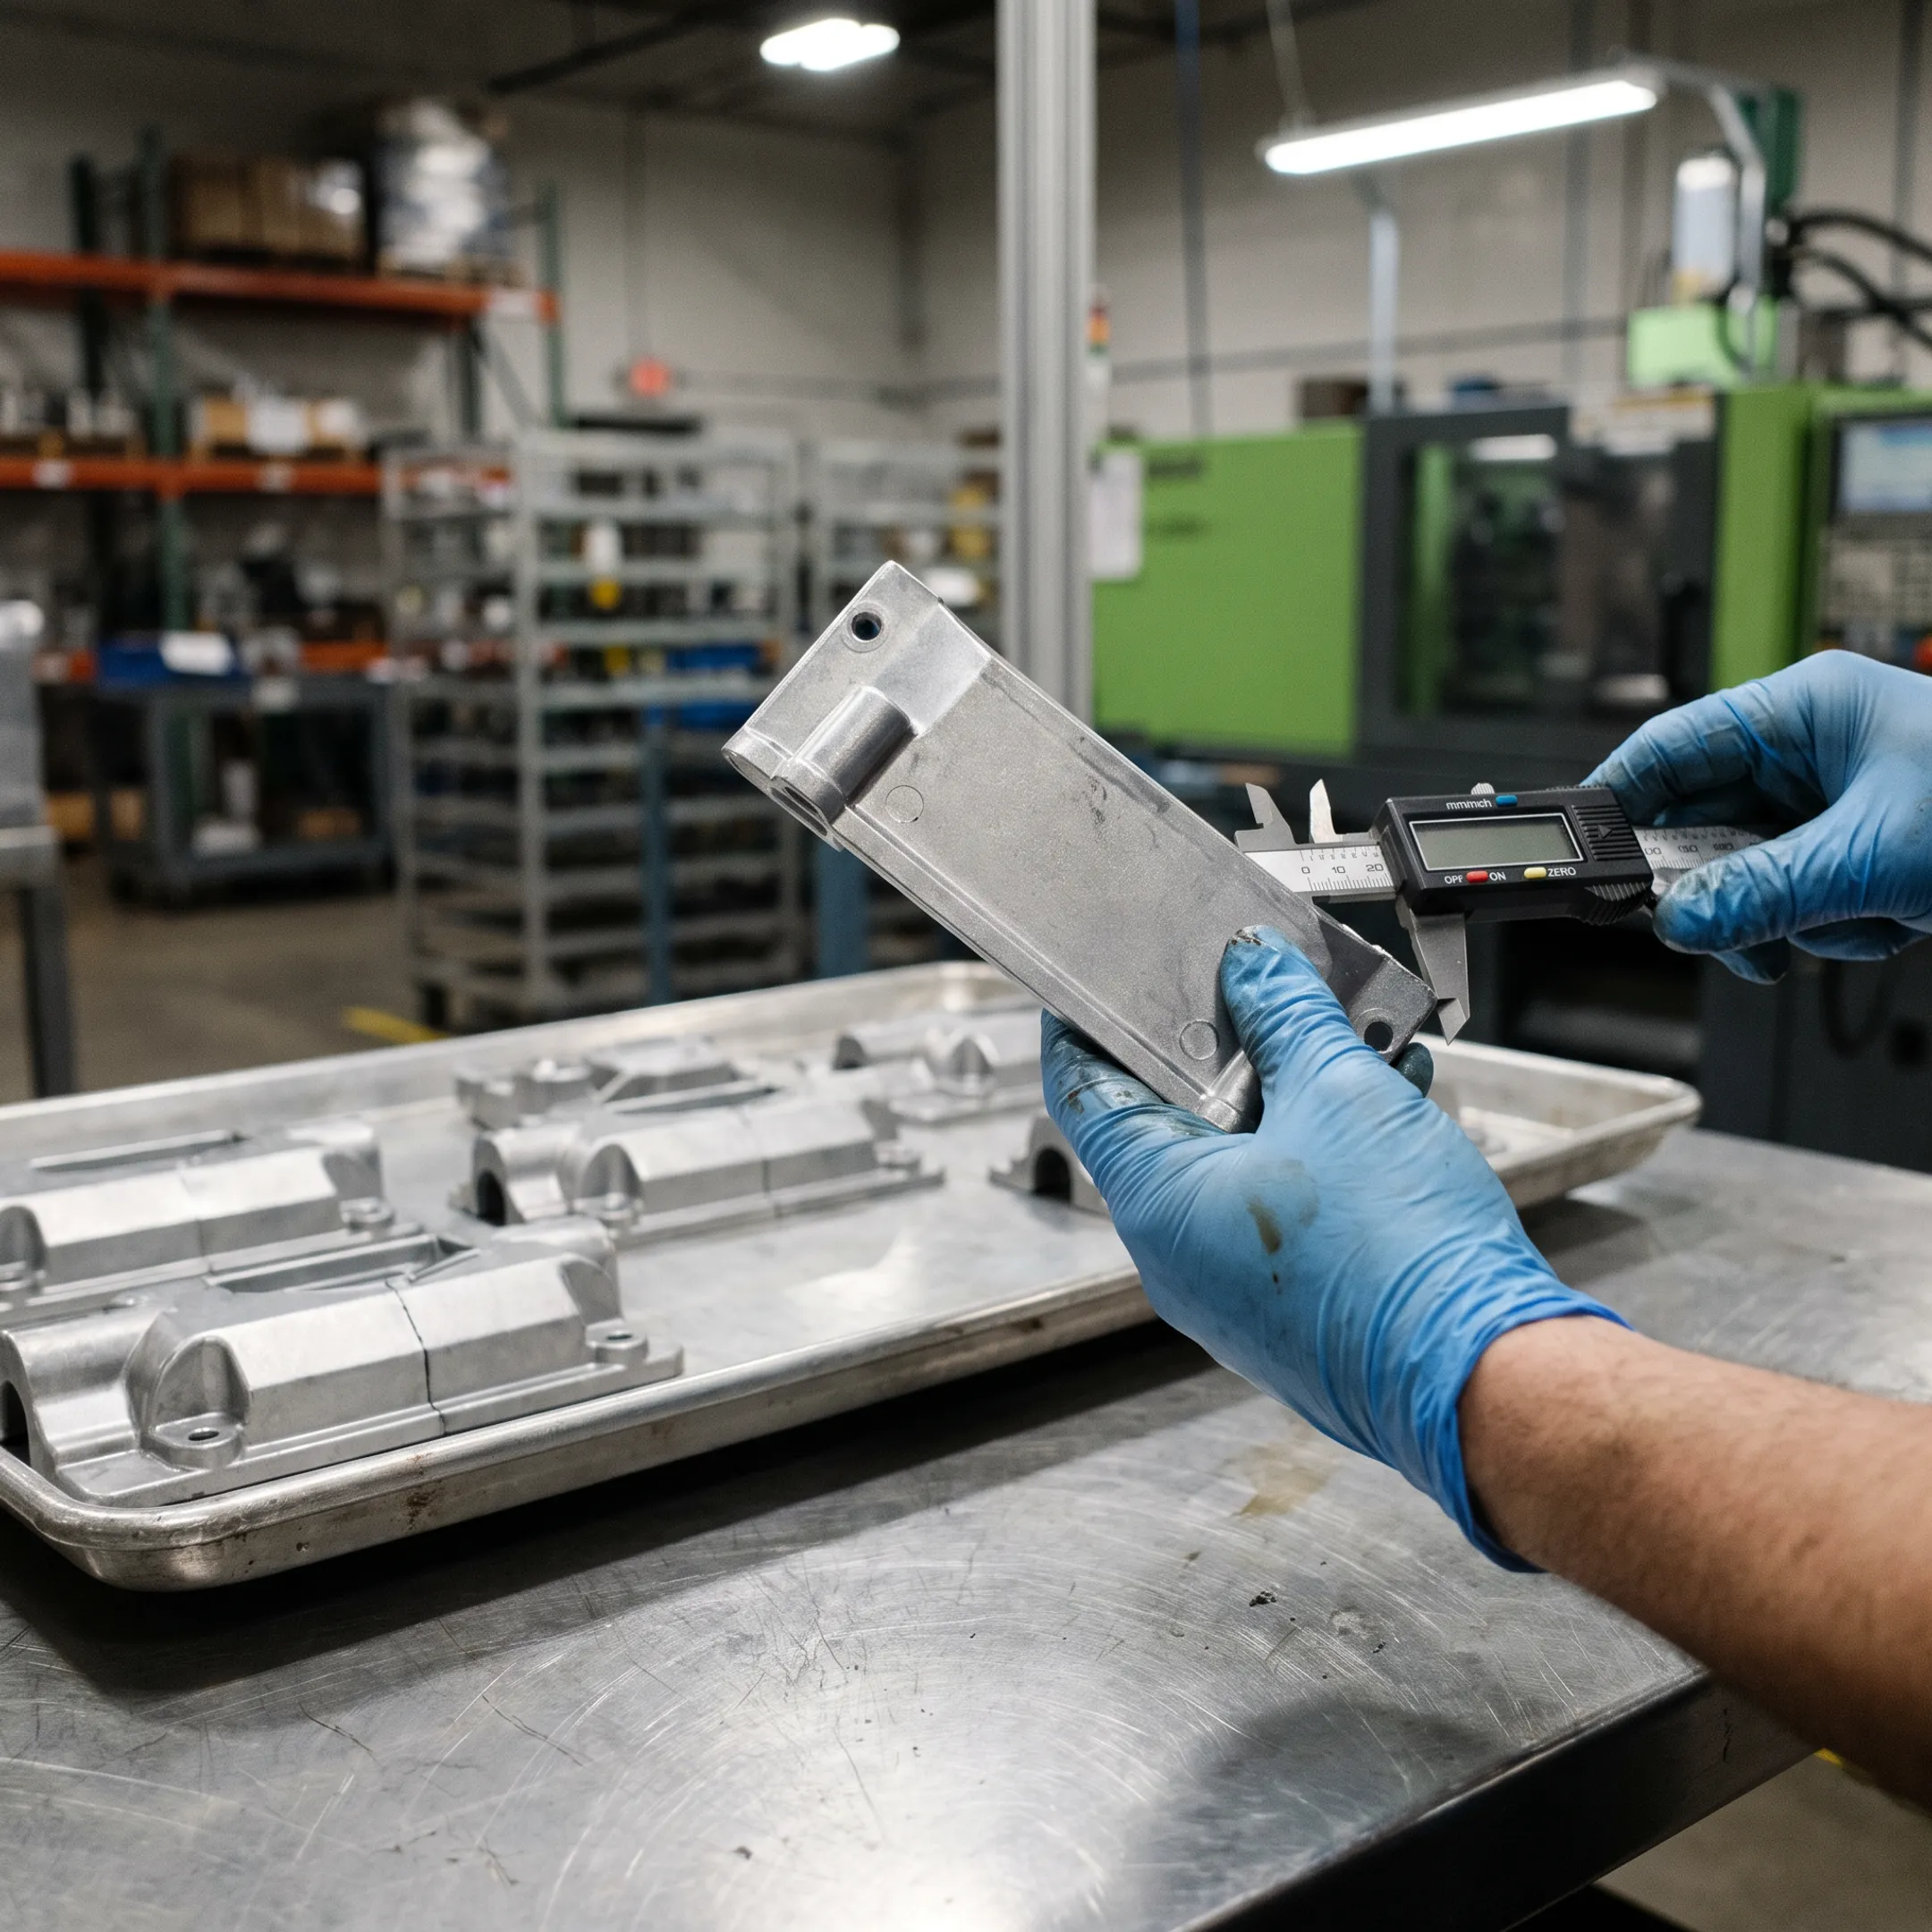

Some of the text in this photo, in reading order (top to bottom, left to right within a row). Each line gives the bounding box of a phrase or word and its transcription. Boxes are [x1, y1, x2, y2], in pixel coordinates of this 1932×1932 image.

[1301, 863, 1385, 874] 0 10 20
[1547, 867, 1577, 877] ZERO
[1489, 871, 1507, 882] ON
